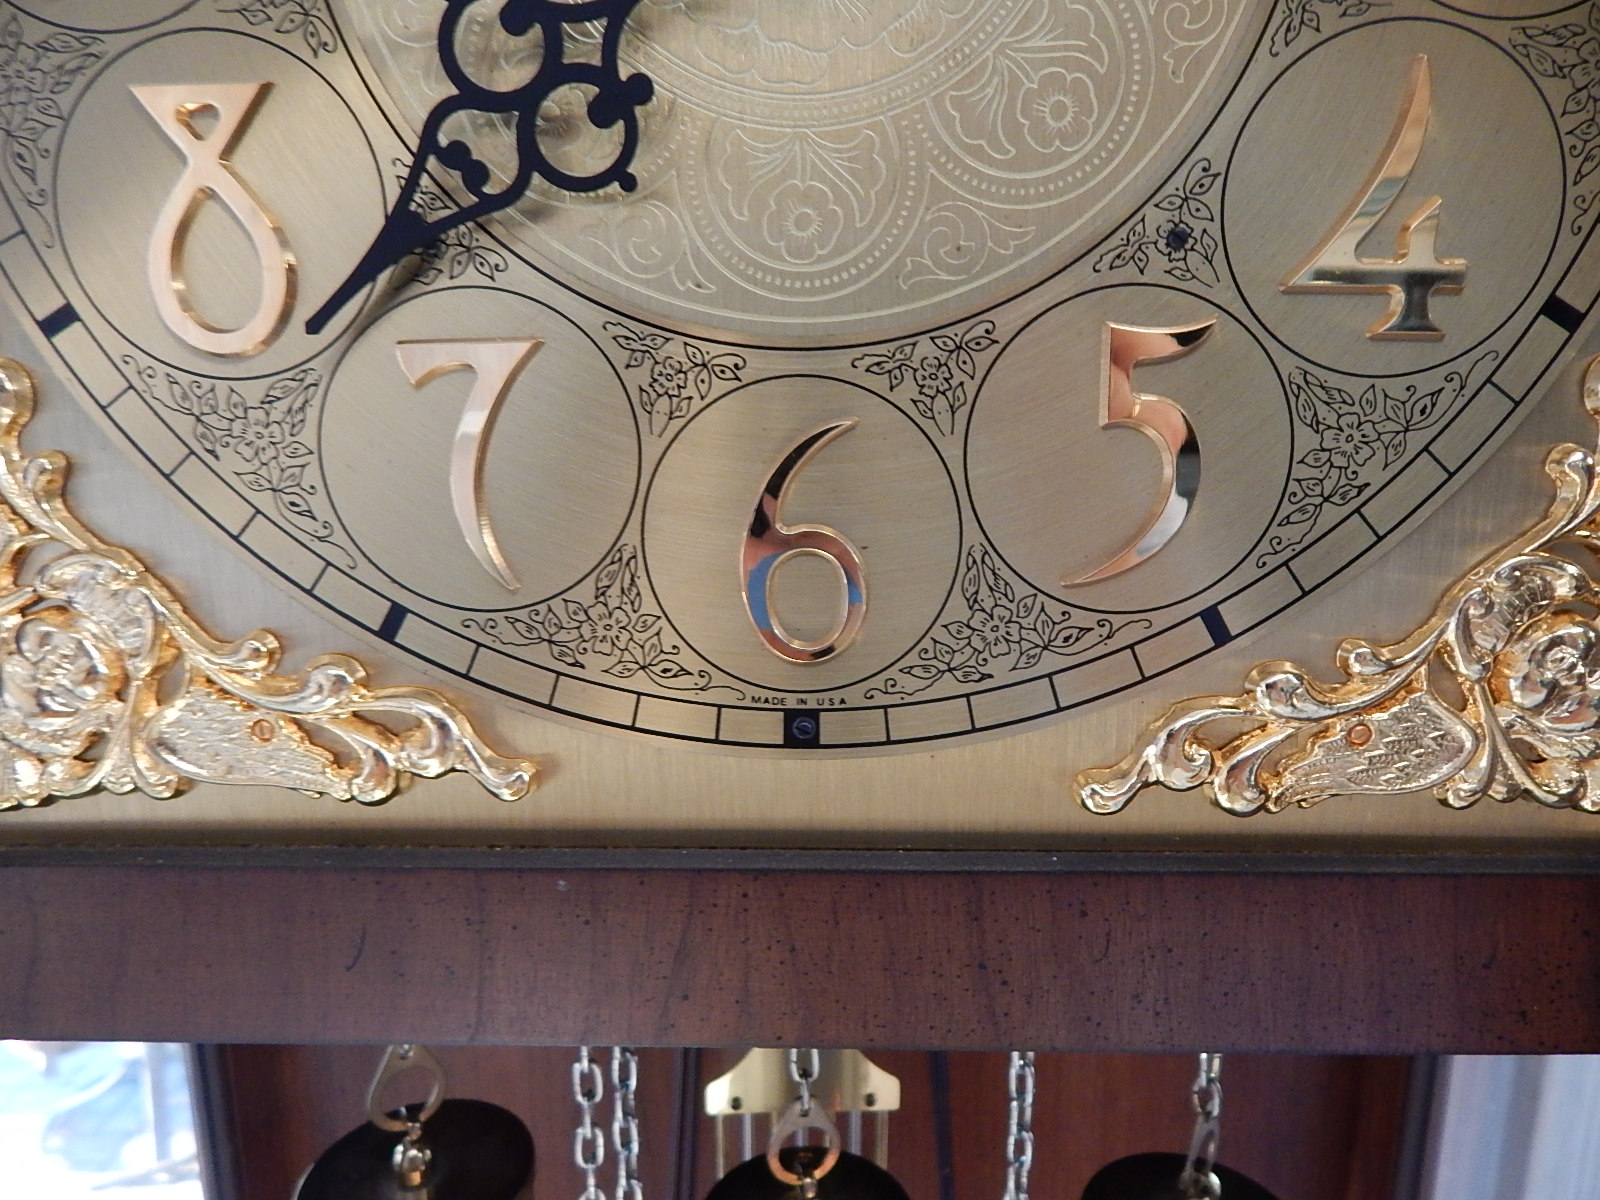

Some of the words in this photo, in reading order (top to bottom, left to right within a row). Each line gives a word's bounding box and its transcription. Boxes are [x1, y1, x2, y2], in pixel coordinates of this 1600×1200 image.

[128, 81, 297, 357] 8
[1278, 53, 1468, 342] 4
[396, 338, 545, 592] 7
[739, 415, 867, 664] 6
[1059, 313, 1219, 588] 5
[751, 695, 787, 706] MADE
[796, 698, 808, 706] IN
